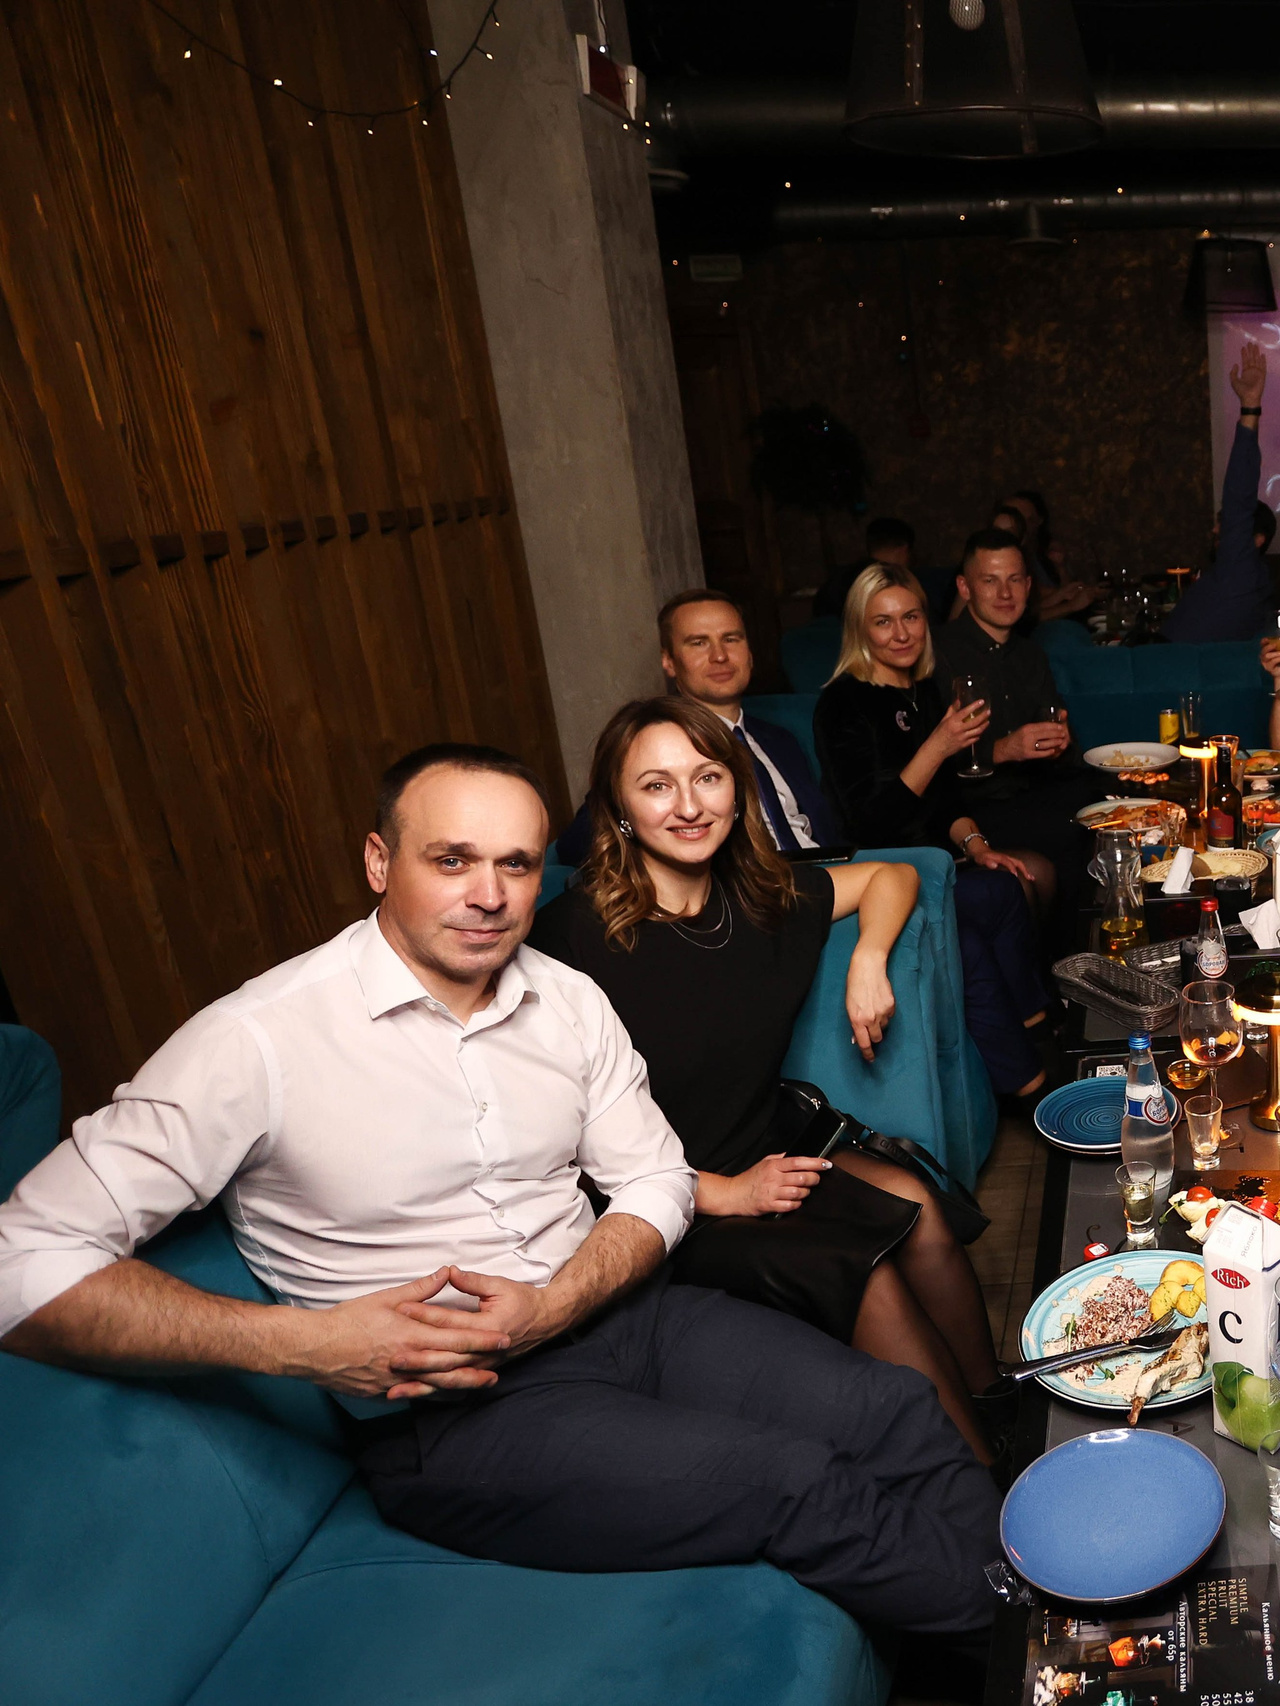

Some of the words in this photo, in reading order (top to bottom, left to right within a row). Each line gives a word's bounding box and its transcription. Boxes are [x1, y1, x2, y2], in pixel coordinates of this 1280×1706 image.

[1240, 1225, 1258, 1258] Яблоко
[1216, 1267, 1245, 1289] Rich
[1218, 1310, 1243, 1344] c
[1197, 1582, 1207, 1613] EXTRA
[1207, 1581, 1217, 1623] SPECIAL
[1228, 1579, 1239, 1625] PREMIUM
[1167, 1630, 1175, 1641] от
[1178, 1600, 1188, 1648] Авторские
[1198, 1617, 1208, 1646] HARD
[1261, 1602, 1273, 1651] Кальянное
[1165, 1643, 1177, 1662] 65р
[1218, 1580, 1228, 1608] FRUIT
[1223, 1693, 1232, 1706] 55
[1238, 1578, 1249, 1613] SIMPLE
[1245, 1690, 1254, 1704] 38
[1179, 1651, 1188, 1692] кальяны
[1265, 1654, 1275, 1681] меню
[1211, 1693, 1220, 1706] 50
[1233, 1692, 1243, 1704] 42
